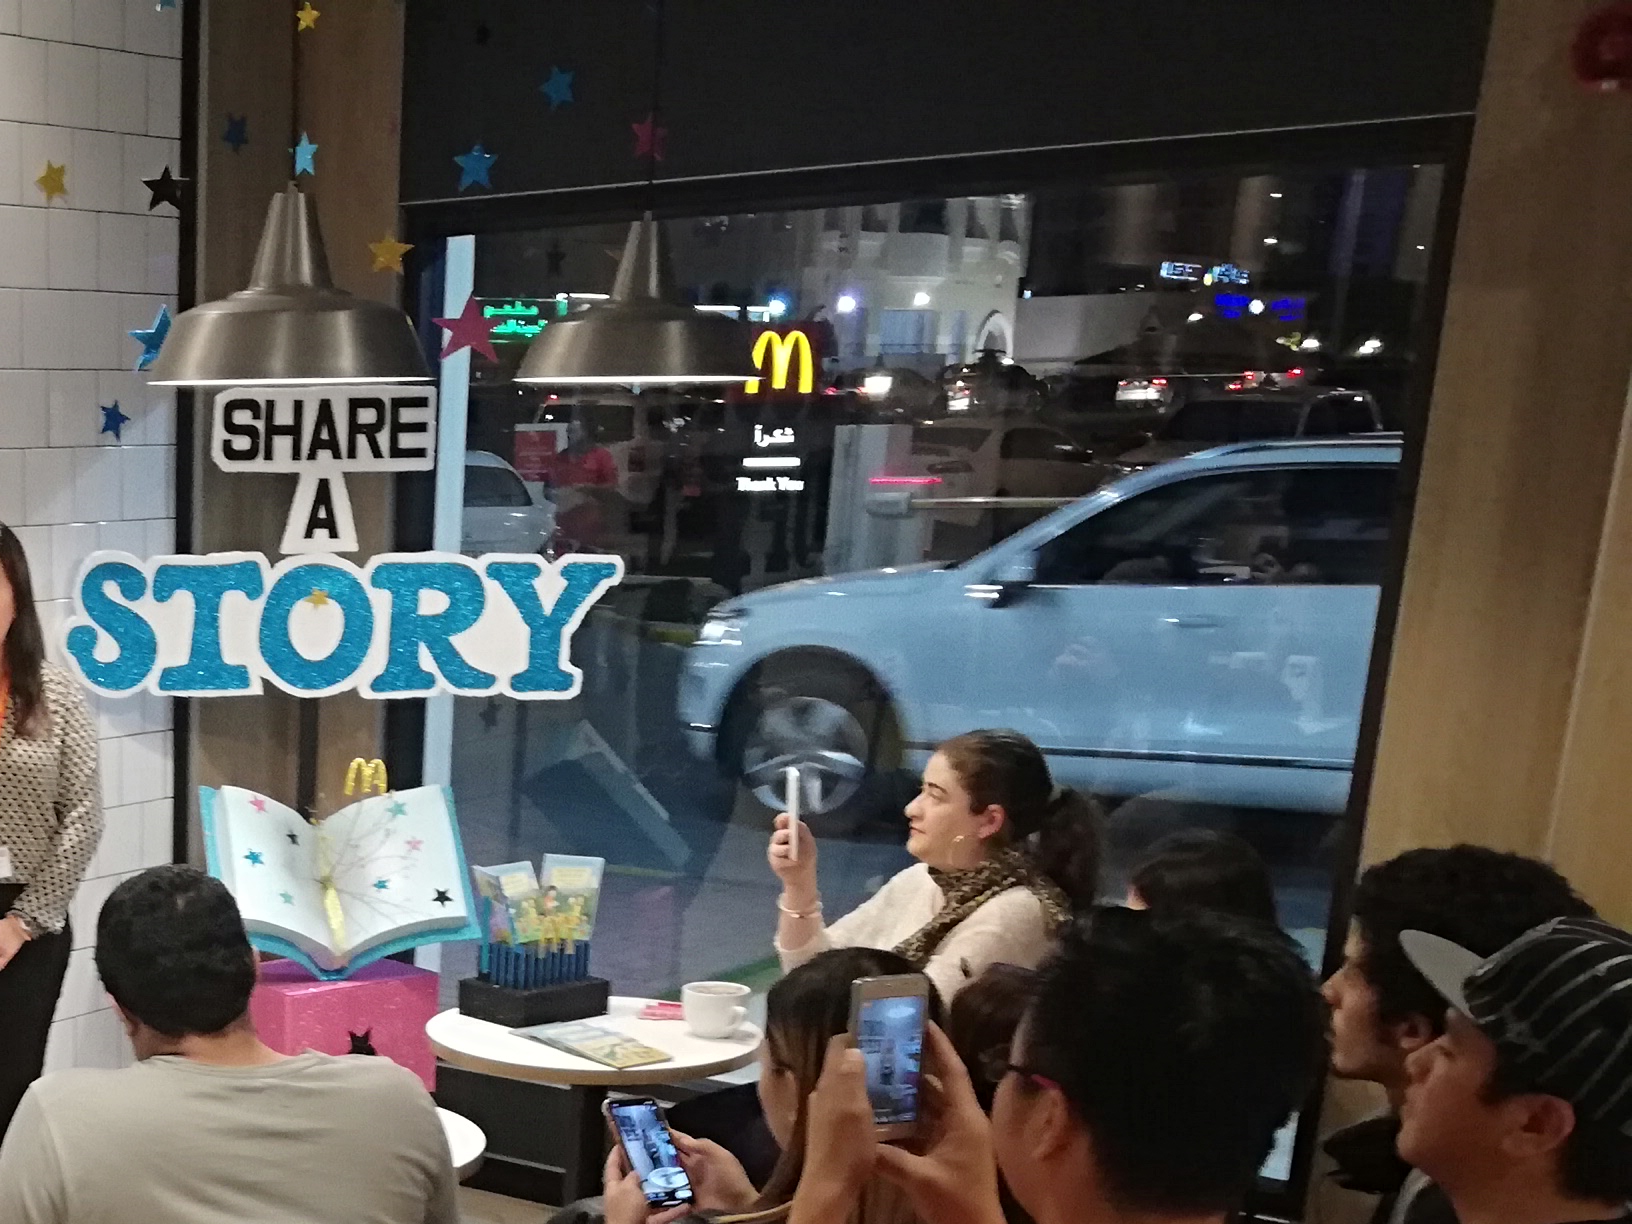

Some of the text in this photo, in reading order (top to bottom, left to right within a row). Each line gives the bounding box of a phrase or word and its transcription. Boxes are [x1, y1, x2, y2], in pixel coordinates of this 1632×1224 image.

[222, 397, 429, 462] SHARE
[304, 477, 339, 539] A
[66, 560, 621, 692] STORY
